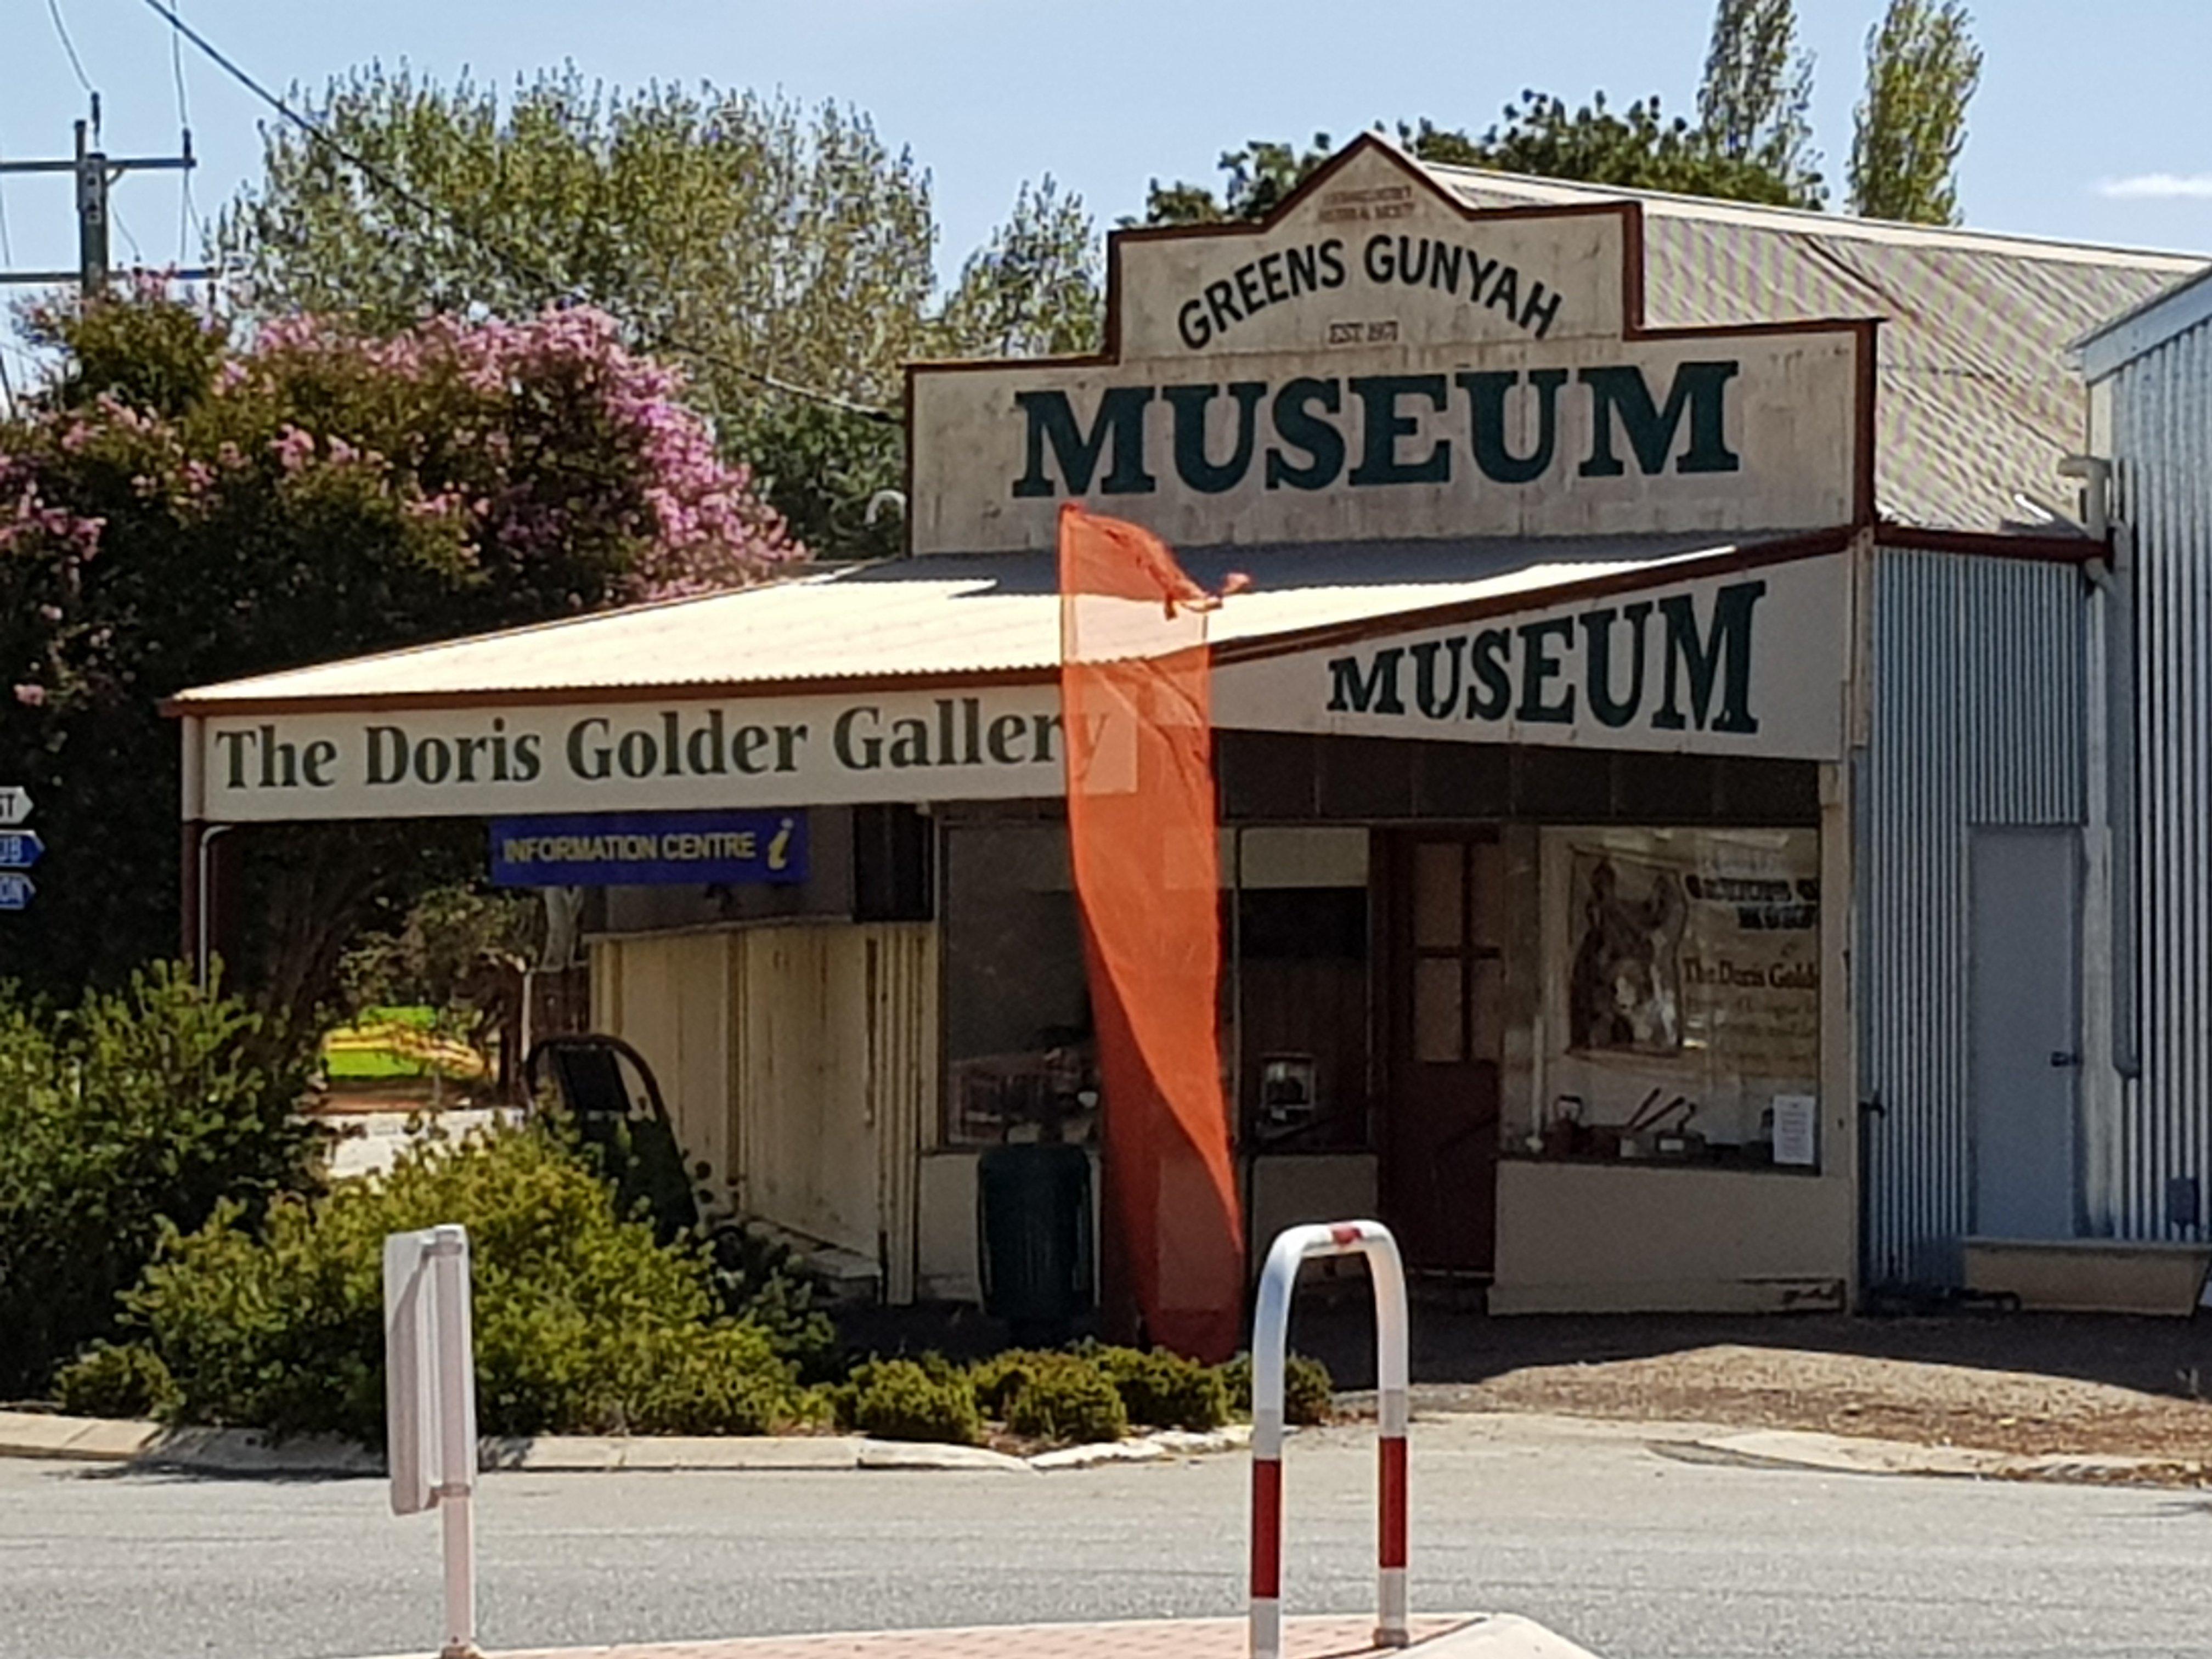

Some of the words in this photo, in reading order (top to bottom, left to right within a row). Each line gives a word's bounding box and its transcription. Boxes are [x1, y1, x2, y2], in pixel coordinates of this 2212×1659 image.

[1177, 238, 1346, 349] GREENS
[1364, 234, 1562, 339] GUNYAH
[1329, 322, 1363, 344] EST
[1012, 360, 1740, 498] MUSEUM
[1327, 580, 1766, 733] MUSEUM
[216, 724, 337, 788] The
[364, 716, 541, 785] Doris
[567, 708, 808, 781] Golder
[503, 835, 657, 864] INFORMATION
[662, 832, 756, 860] CENTRE
